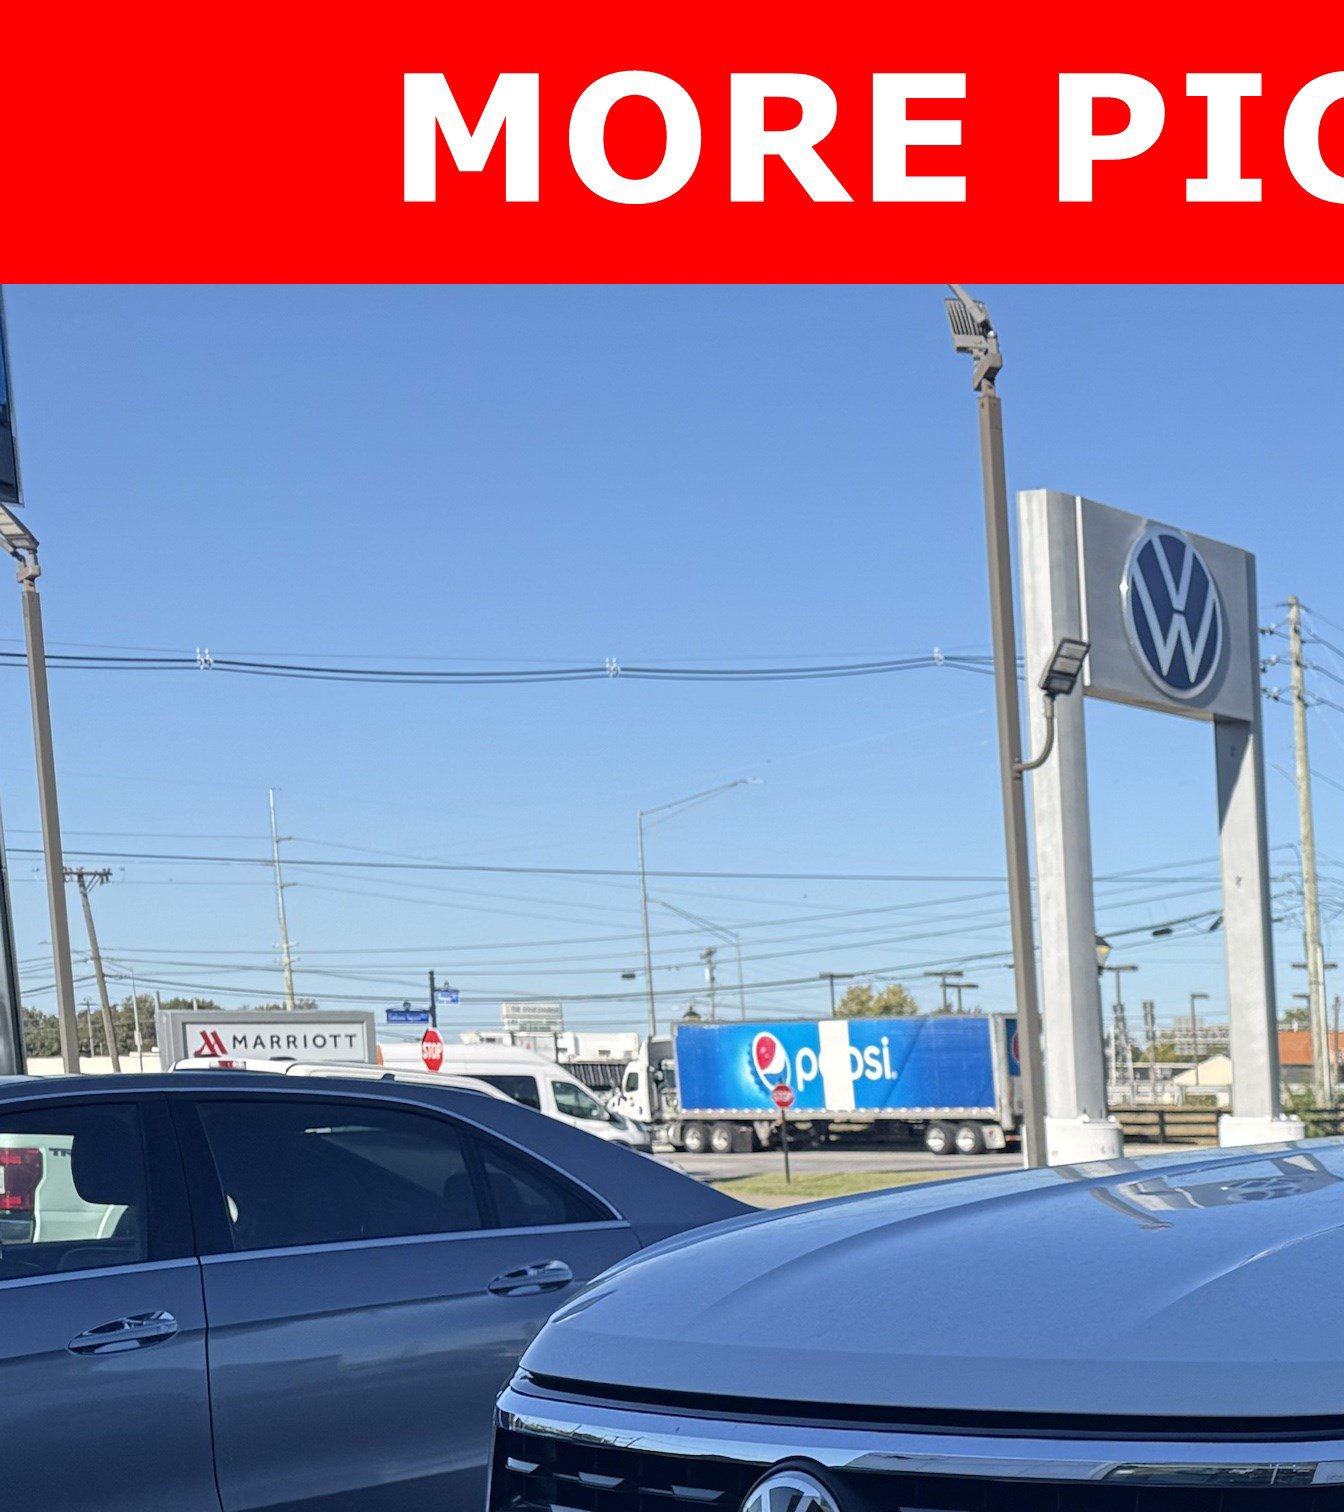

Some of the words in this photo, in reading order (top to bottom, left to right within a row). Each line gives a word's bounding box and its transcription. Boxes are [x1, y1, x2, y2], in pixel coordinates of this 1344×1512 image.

[232, 1033, 357, 1050] MARRIOTT
[421, 1041, 444, 1061] STOP
[795, 1036, 891, 1092] ppsi
